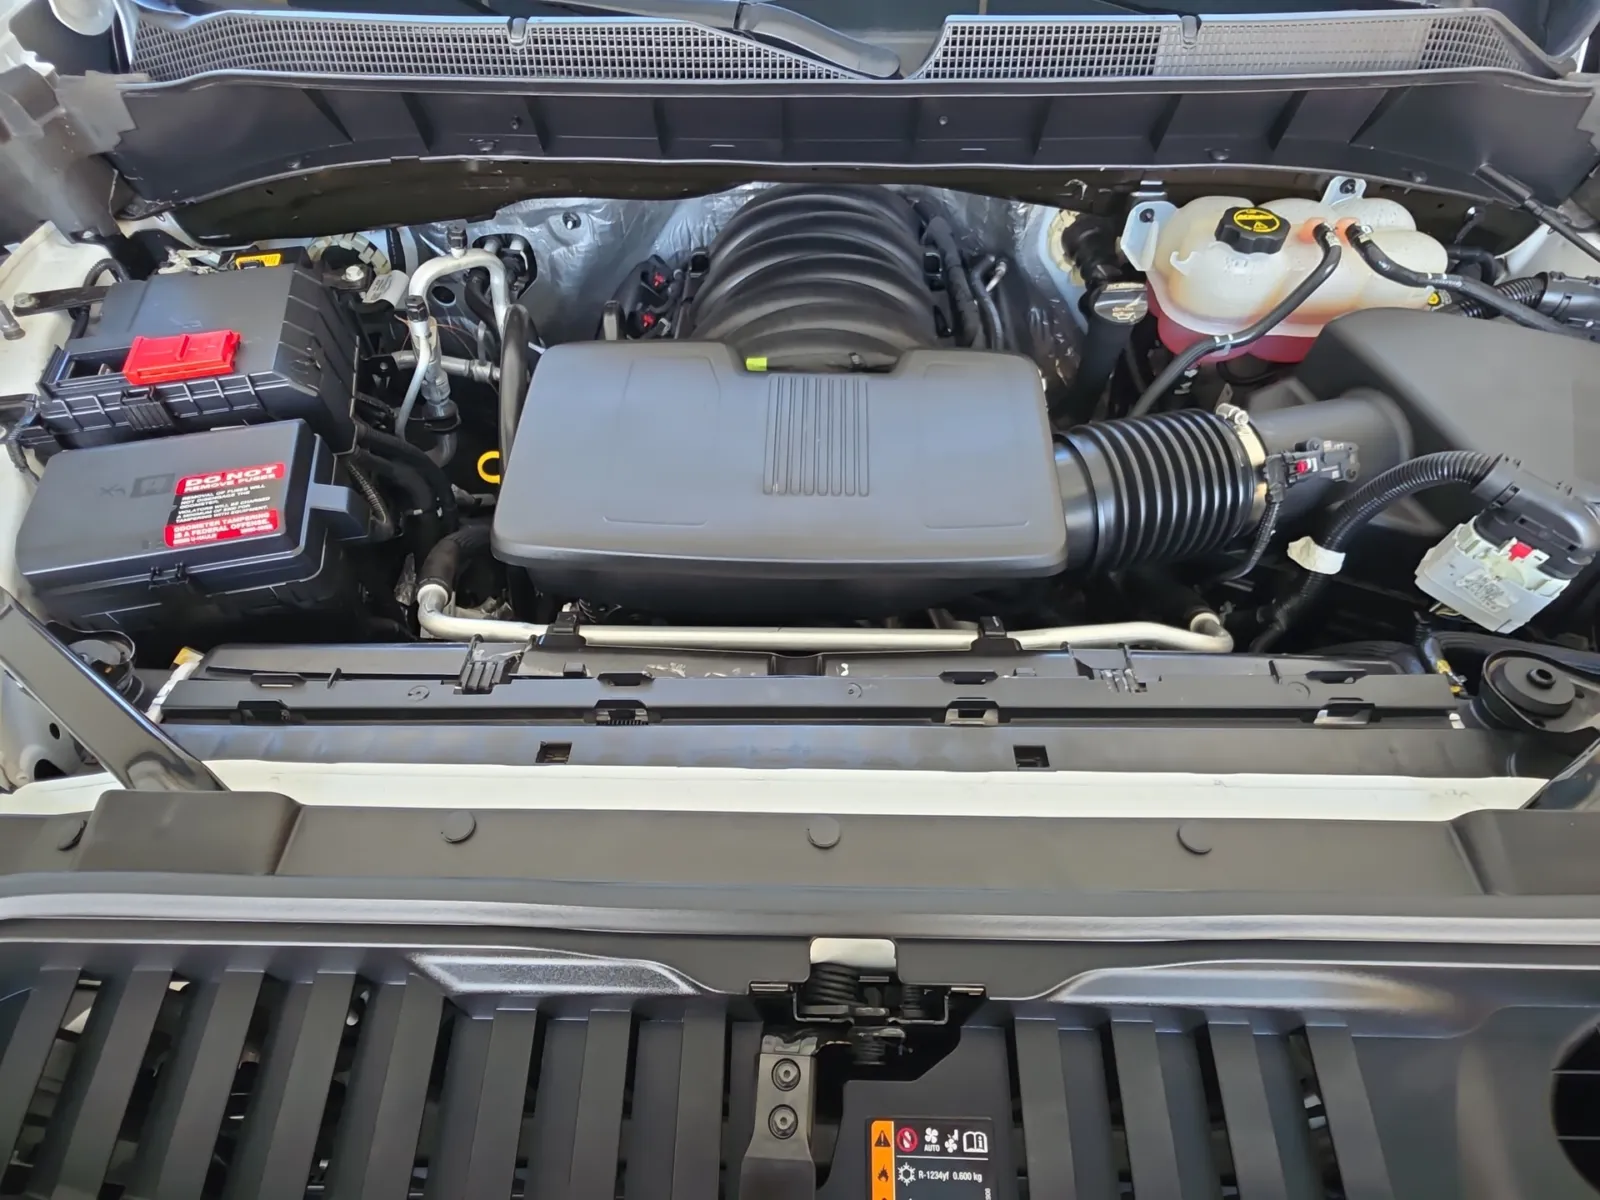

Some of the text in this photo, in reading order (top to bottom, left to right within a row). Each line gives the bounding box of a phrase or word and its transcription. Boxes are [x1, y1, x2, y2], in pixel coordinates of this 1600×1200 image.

[184, 474, 276, 492] REMOVE FUSES
[185, 466, 277, 487] DO NOT
[182, 492, 214, 501] REMOVAL
[197, 494, 236, 503] DISENGAGE
[178, 506, 213, 515] VIOLATORS
[240, 496, 270, 504] CHARGED
[176, 514, 213, 524] TAMPERING
[183, 510, 213, 519] MINIMUM
[173, 512, 270, 532] ODOMETER TAMPERING
[173, 531, 183, 539] IS
[183, 530, 191, 538] A
[191, 525, 229, 537] FEDERAL
[924, 1144, 940, 1152] AUTO
[918, 1170, 983, 1183] R-1234yf 0.600 kg
